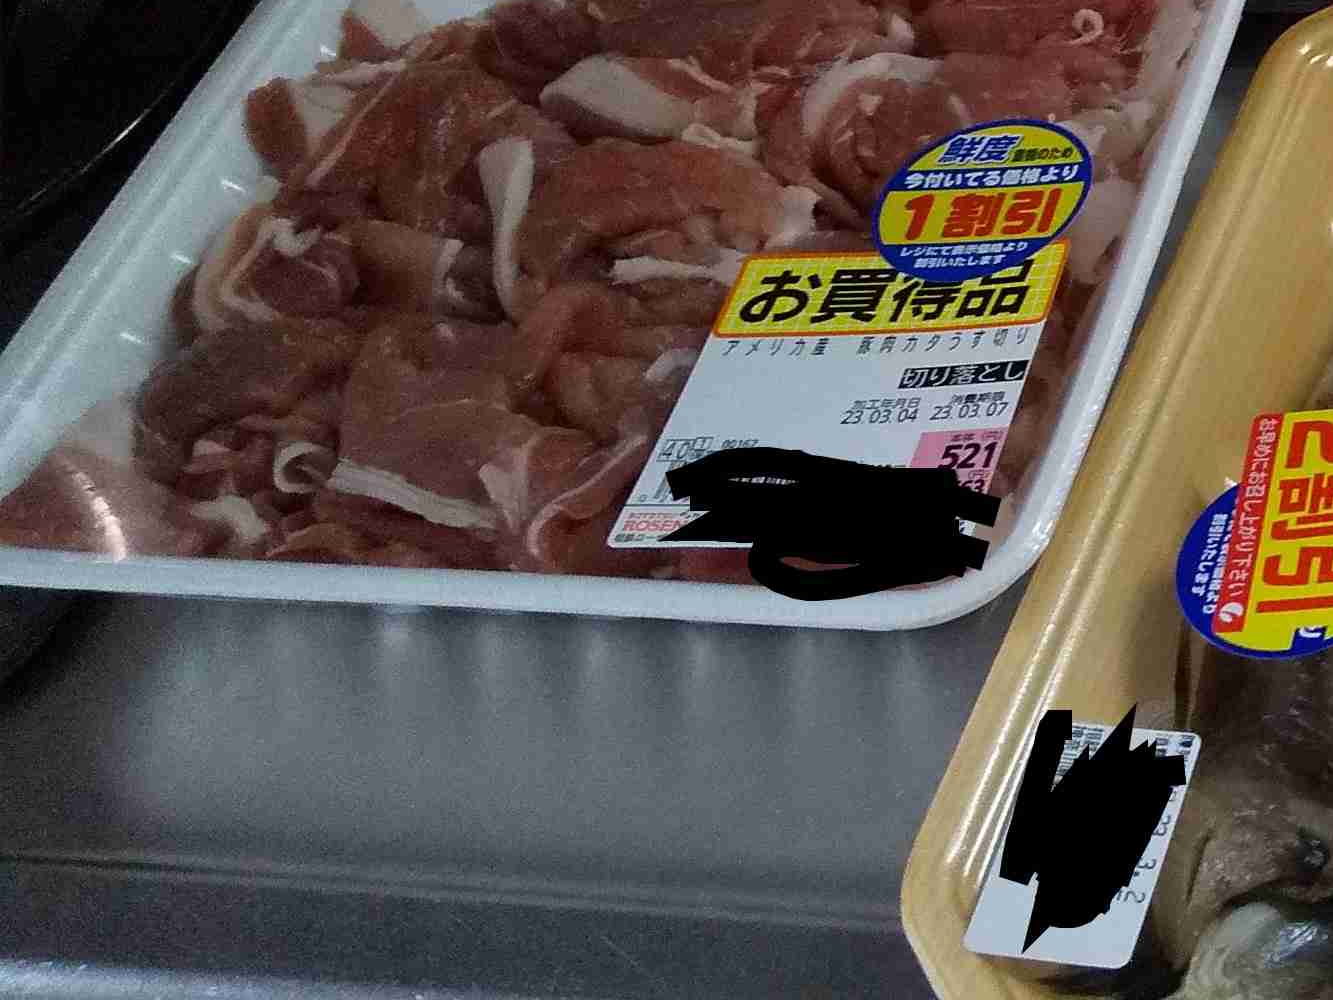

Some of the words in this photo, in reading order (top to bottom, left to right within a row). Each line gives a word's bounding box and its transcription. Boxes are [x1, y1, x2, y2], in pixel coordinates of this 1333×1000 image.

[937, 133, 1023, 166] 鮮度
[903, 164, 1080, 190] 今付いてる価格より
[904, 187, 1063, 241] 1割引
[721, 337, 830, 357] アメリカ産
[901, 361, 1026, 388] 切り落とし
[937, 441, 999, 470] 521
